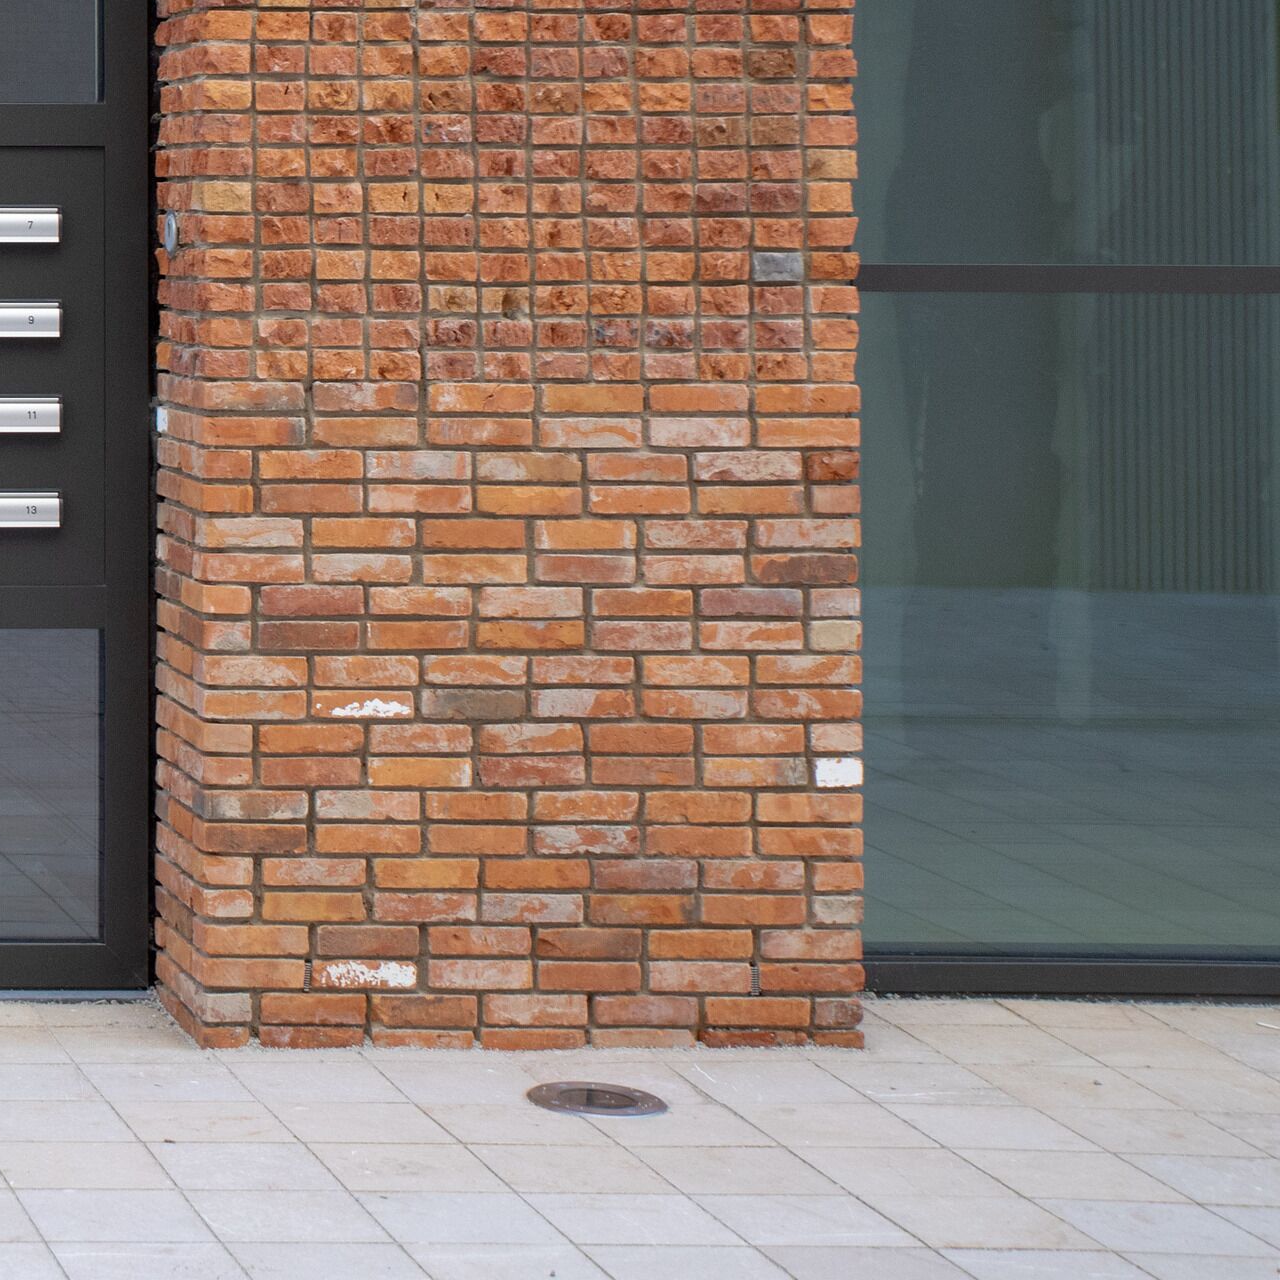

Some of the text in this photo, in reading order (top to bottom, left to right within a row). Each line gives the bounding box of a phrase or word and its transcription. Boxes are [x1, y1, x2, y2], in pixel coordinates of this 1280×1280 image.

[27, 220, 34, 229] 7
[28, 315, 35, 325] 9
[27, 410, 37, 420] 11
[26, 505, 38, 515] 13
